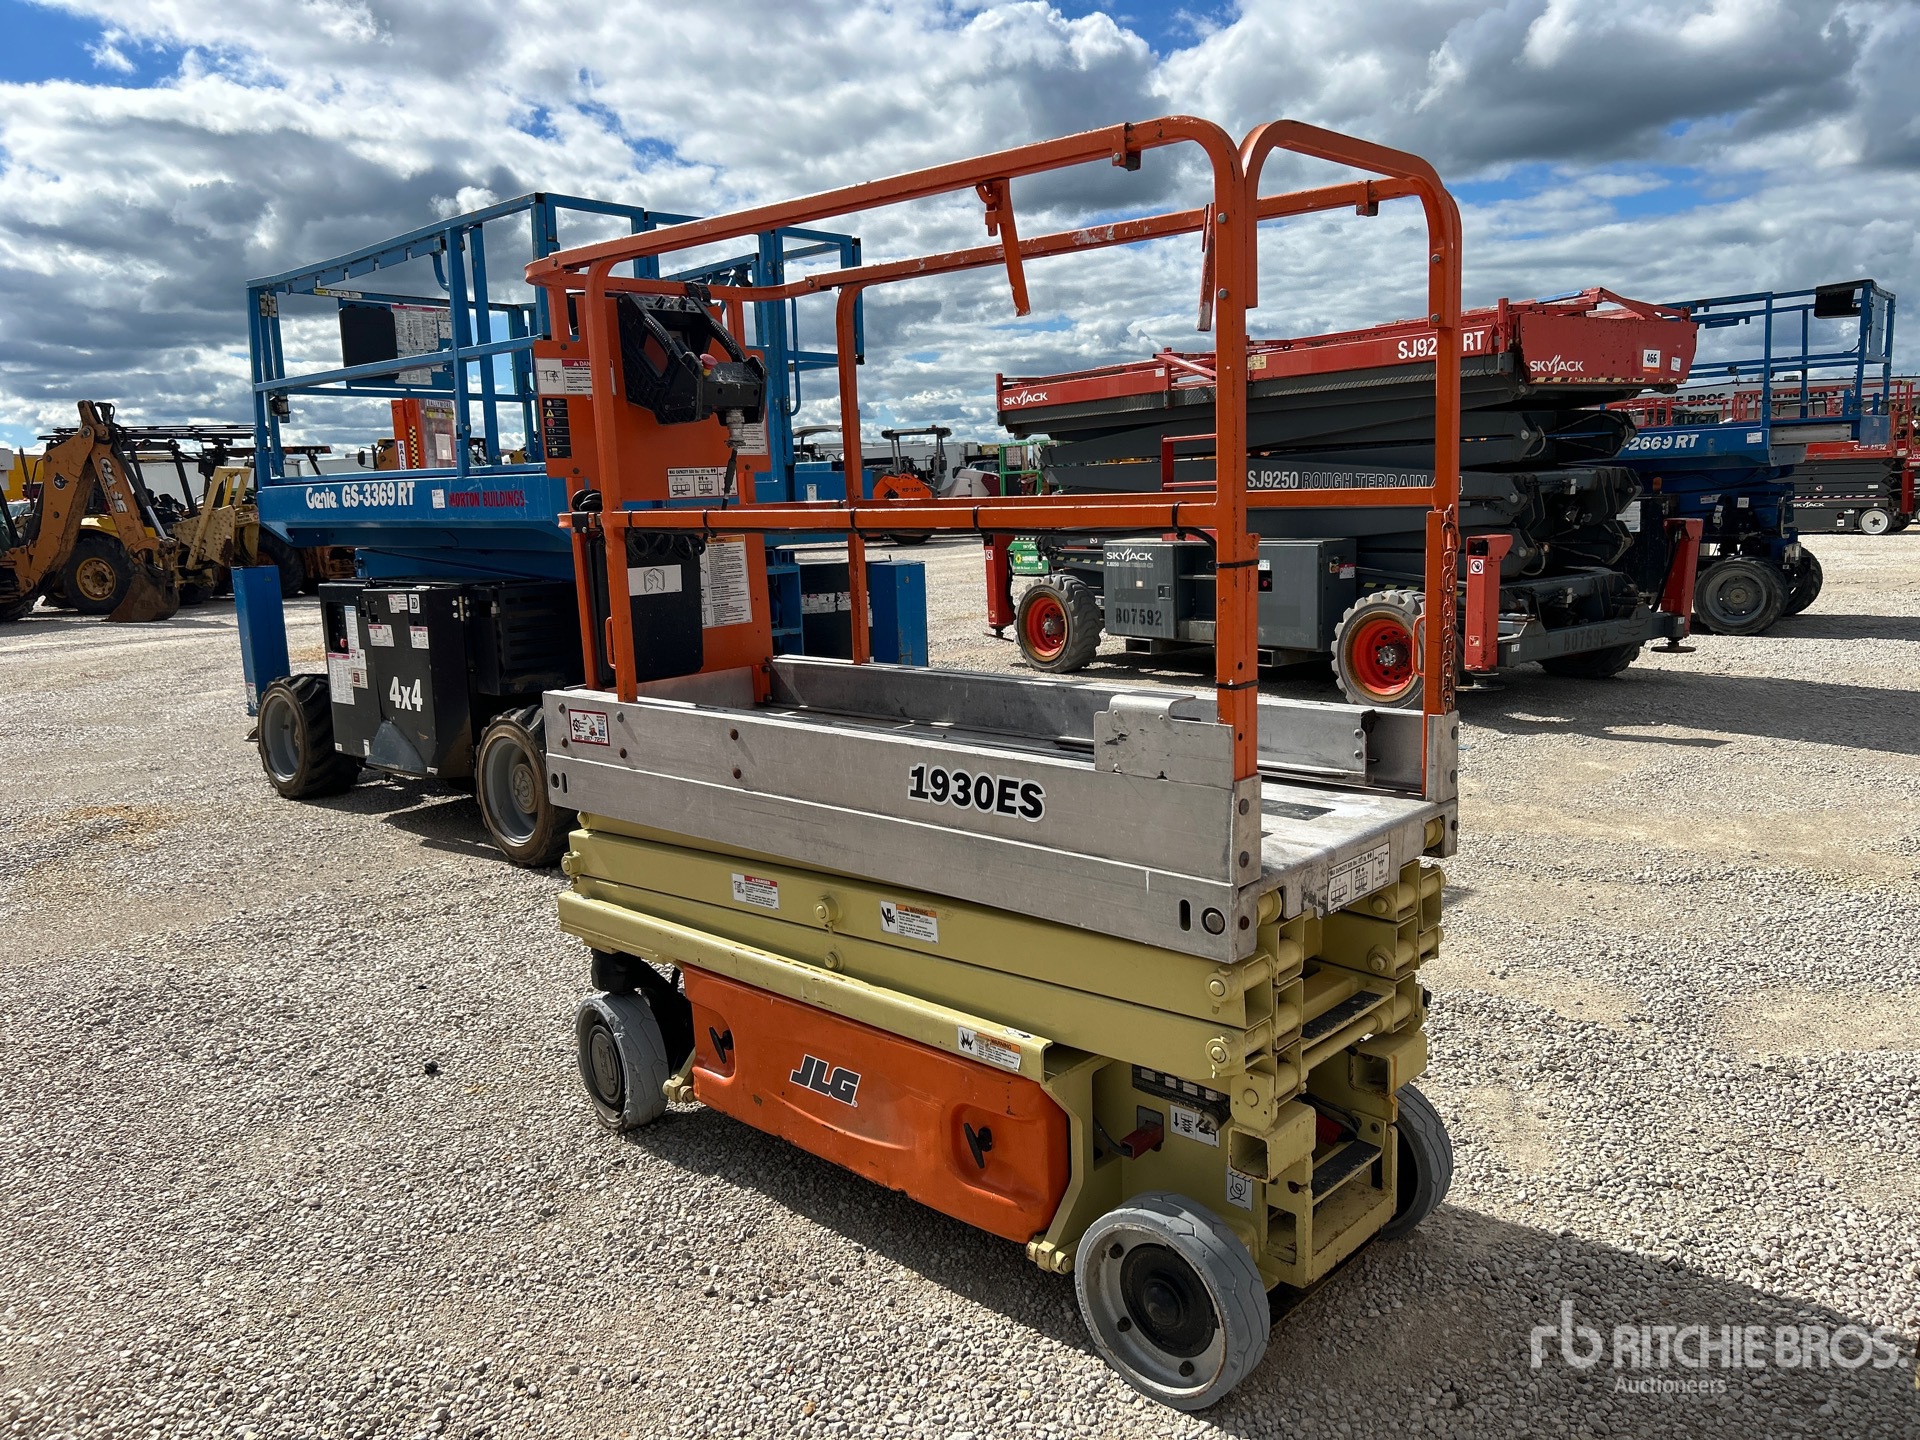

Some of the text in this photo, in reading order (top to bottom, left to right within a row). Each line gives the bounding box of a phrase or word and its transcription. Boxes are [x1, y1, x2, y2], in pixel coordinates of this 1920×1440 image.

[1463, 331, 1484, 351] RT
[1529, 355, 1584, 374] SKYJACK
[1646, 353, 1658, 364] 466
[1003, 390, 1048, 406] SKYJACK
[1674, 433, 1699, 449] RT
[1247, 470, 1428, 489] SJ9250 ROUGH TERRAIN
[305, 487, 339, 509] Genie
[342, 482, 395, 508] GS-3369
[397, 482, 415, 506] RT
[448, 491, 480, 508] MORTON
[483, 489, 525, 508] BUILDINGS
[1106, 547, 1153, 562] SKYJACK
[389, 676, 423, 712] 4x4
[909, 764, 1044, 820] 1930ES
[789, 1053, 861, 1107] JLG
